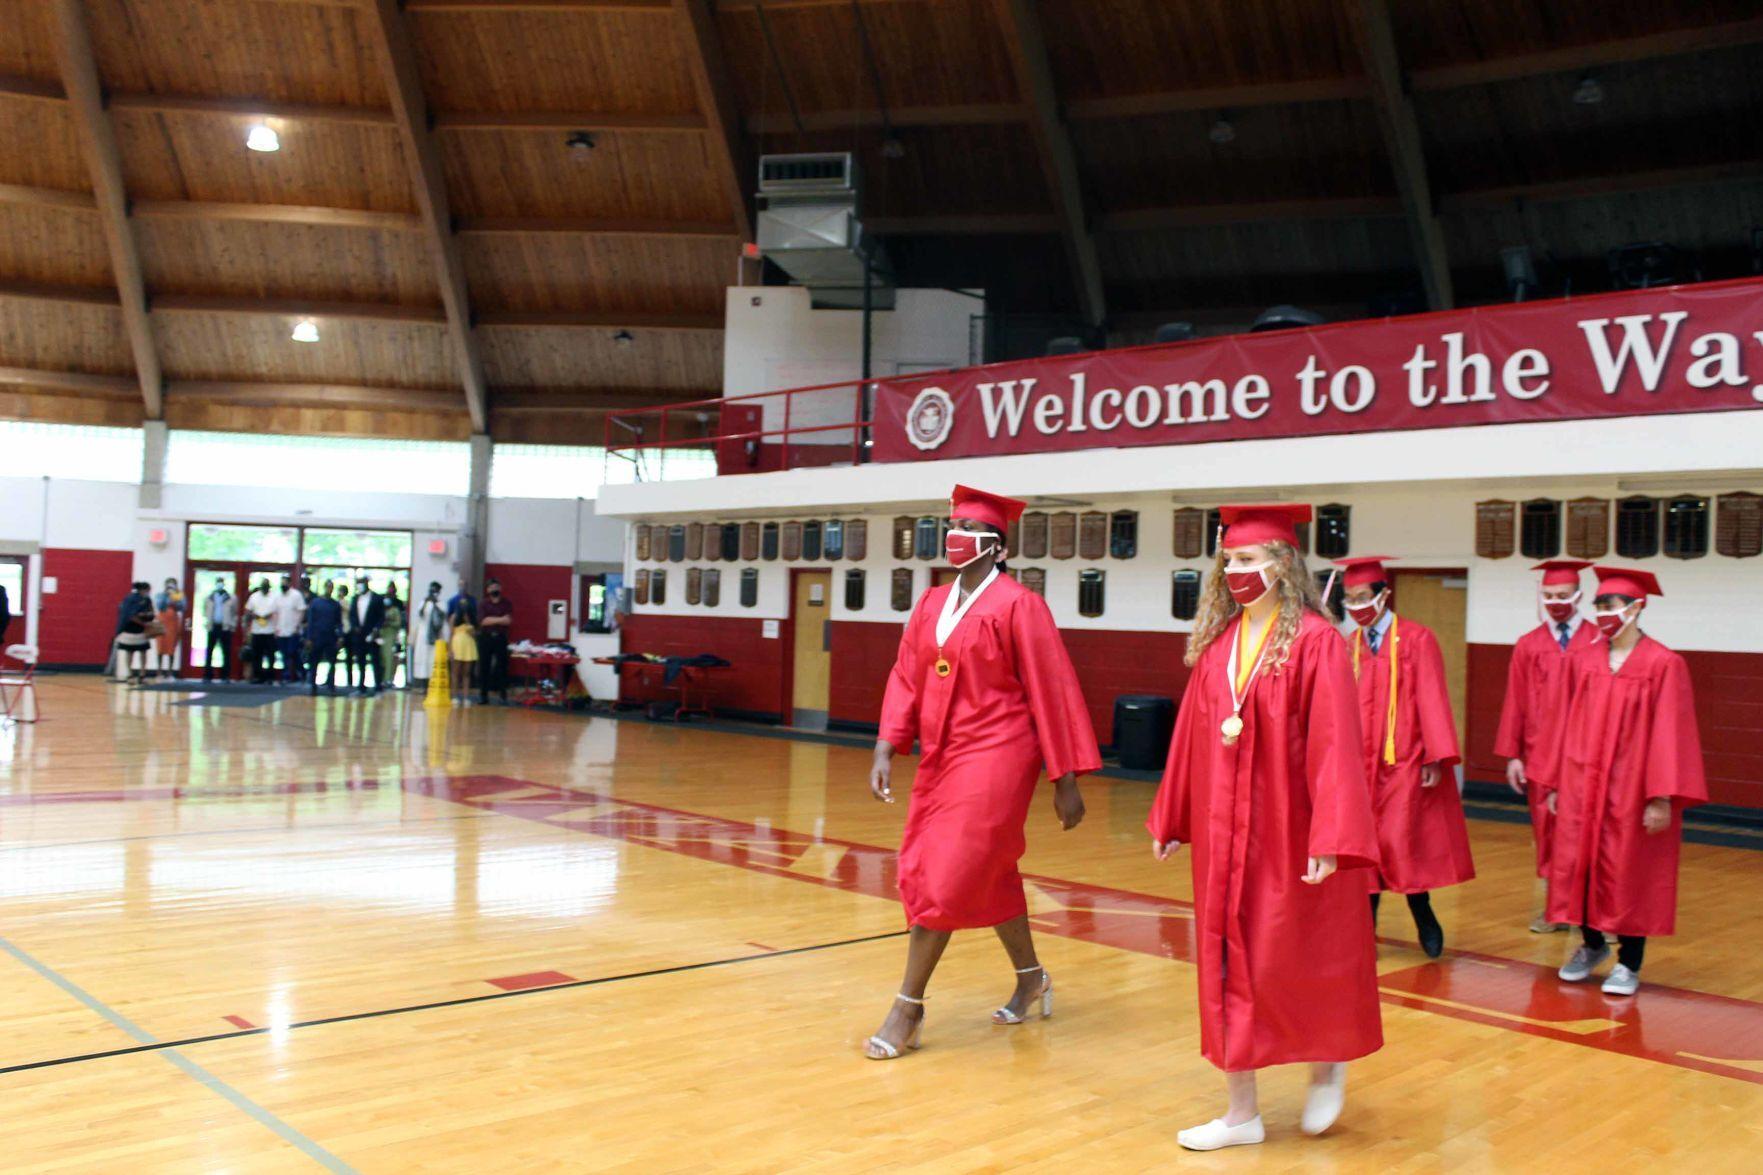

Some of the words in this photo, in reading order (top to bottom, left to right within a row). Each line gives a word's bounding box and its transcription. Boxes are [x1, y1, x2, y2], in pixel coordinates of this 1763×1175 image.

[977, 373, 1270, 438] Welcome
[1296, 356, 1374, 414] to
[1404, 333, 1548, 406] the
[1578, 312, 1763, 401] Wa
